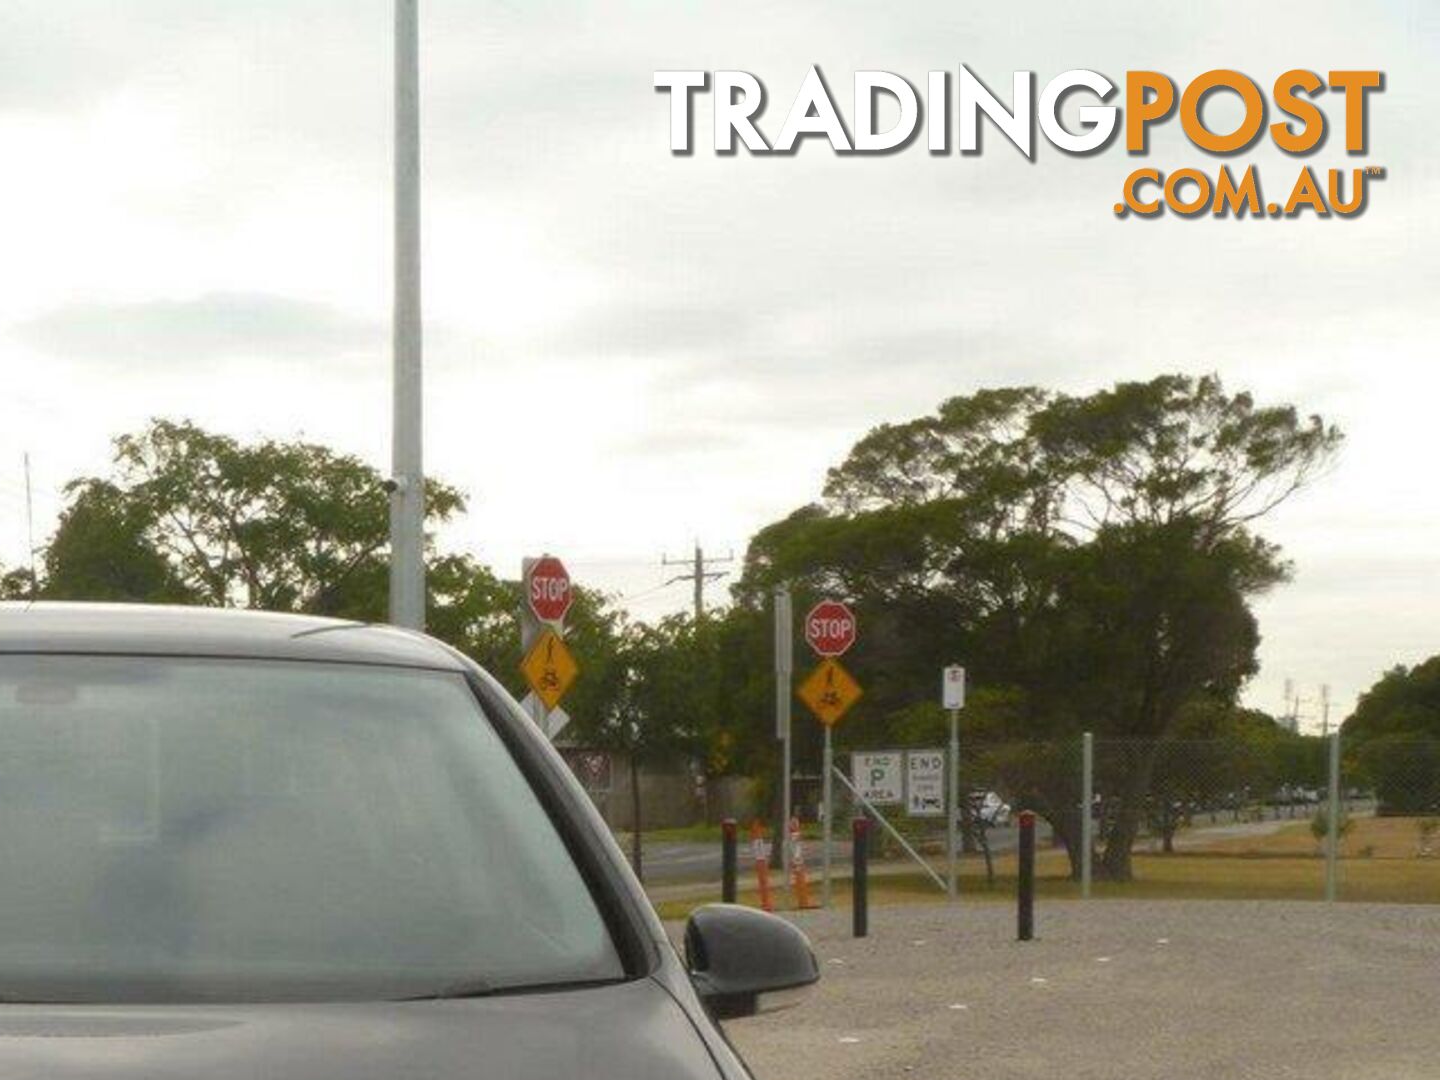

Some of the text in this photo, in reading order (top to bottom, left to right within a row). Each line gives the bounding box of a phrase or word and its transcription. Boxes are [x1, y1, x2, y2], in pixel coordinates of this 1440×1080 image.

[532, 575, 568, 601] STOP
[810, 618, 851, 639] STOP
[910, 757, 942, 770] END
[870, 768, 885, 788] P
